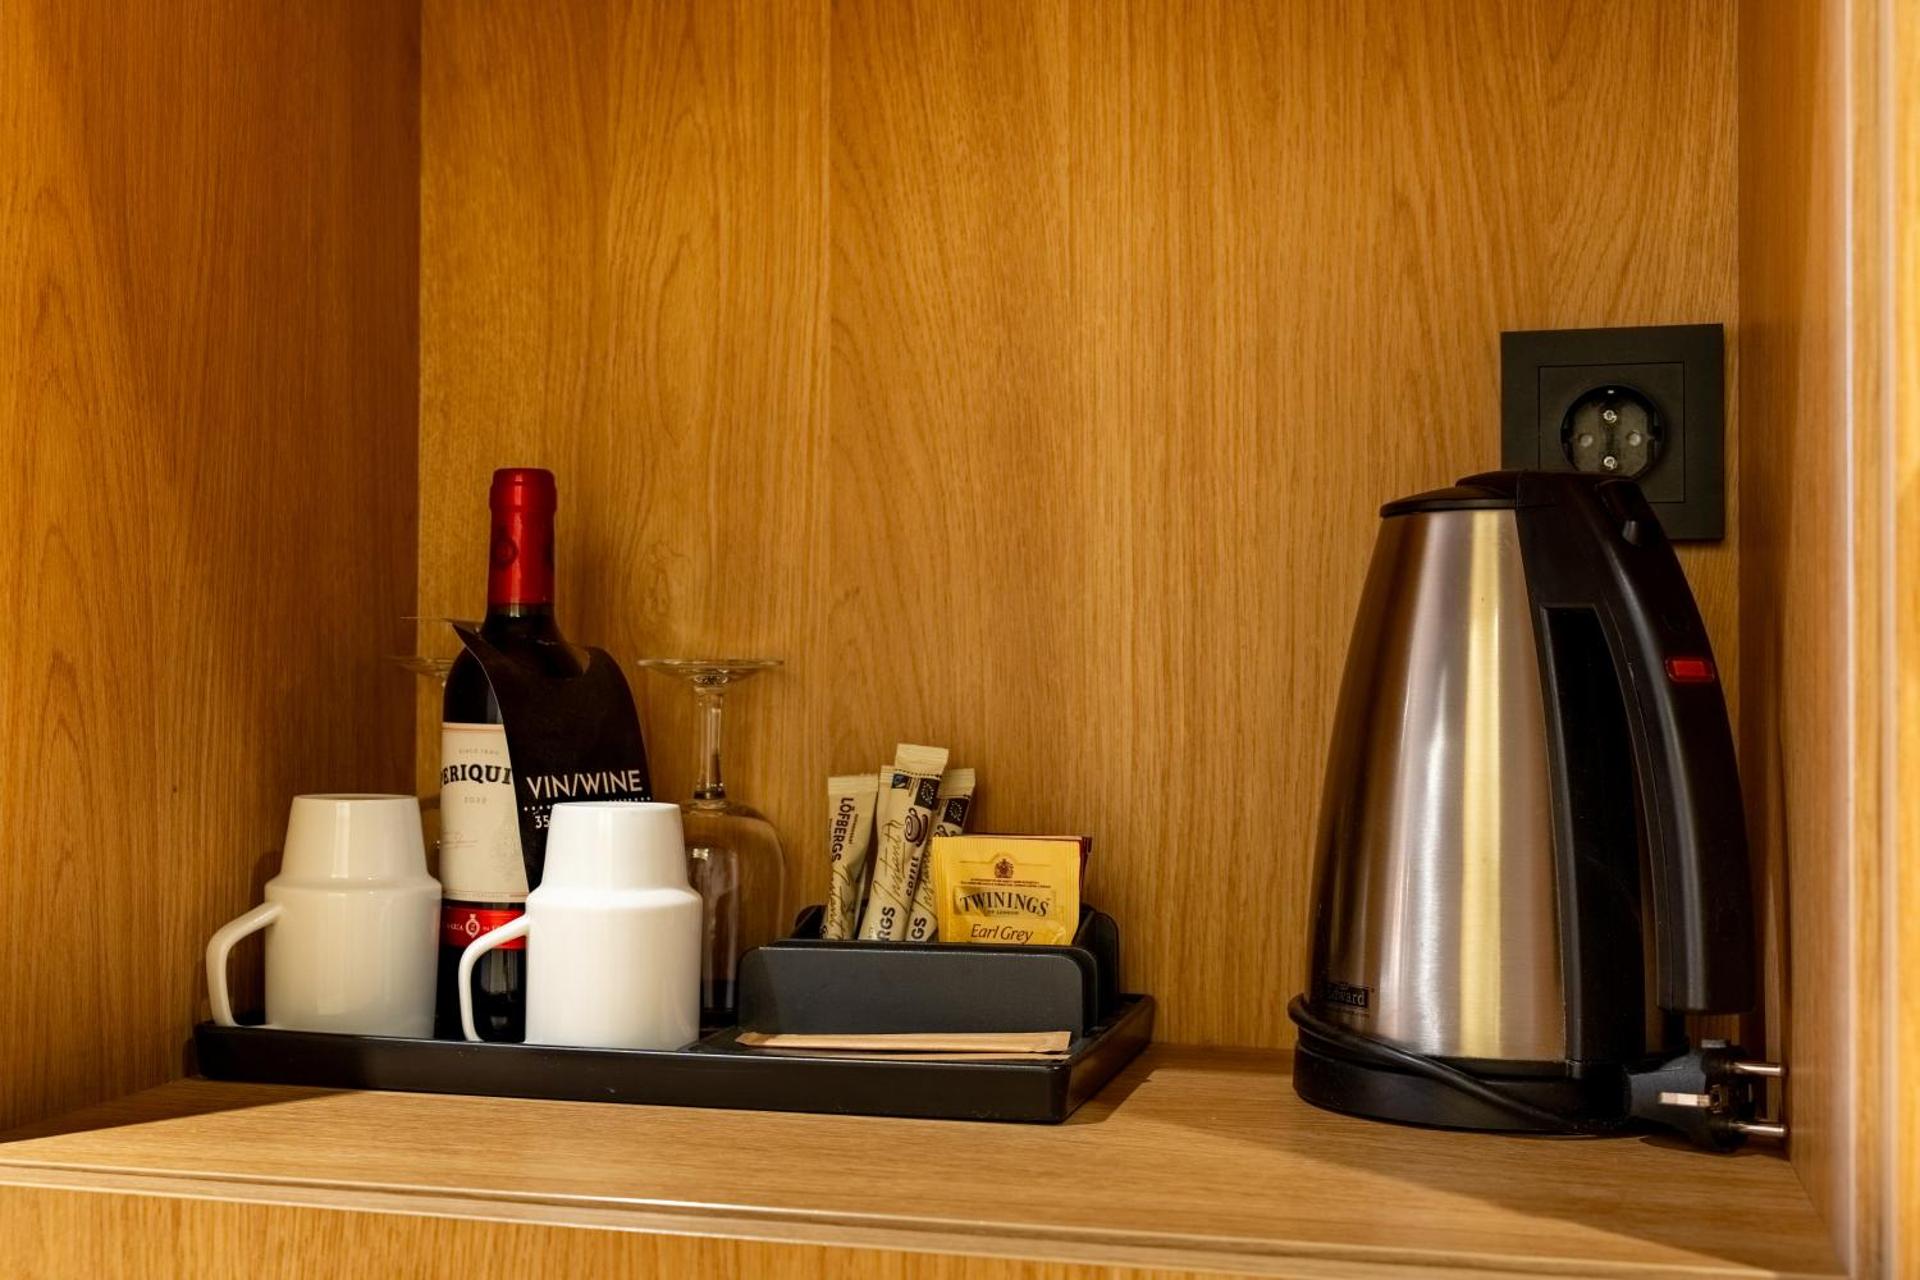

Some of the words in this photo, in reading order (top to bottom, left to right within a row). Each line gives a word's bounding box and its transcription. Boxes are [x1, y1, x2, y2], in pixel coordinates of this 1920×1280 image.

[440, 763, 512, 788] ERIQUI
[526, 769, 643, 799] VIN/WINE
[831, 797, 855, 863] LÖFBERGS
[960, 891, 1049, 917] TWININGS
[971, 923, 999, 939] Earl
[1001, 926, 1034, 943] Grey
